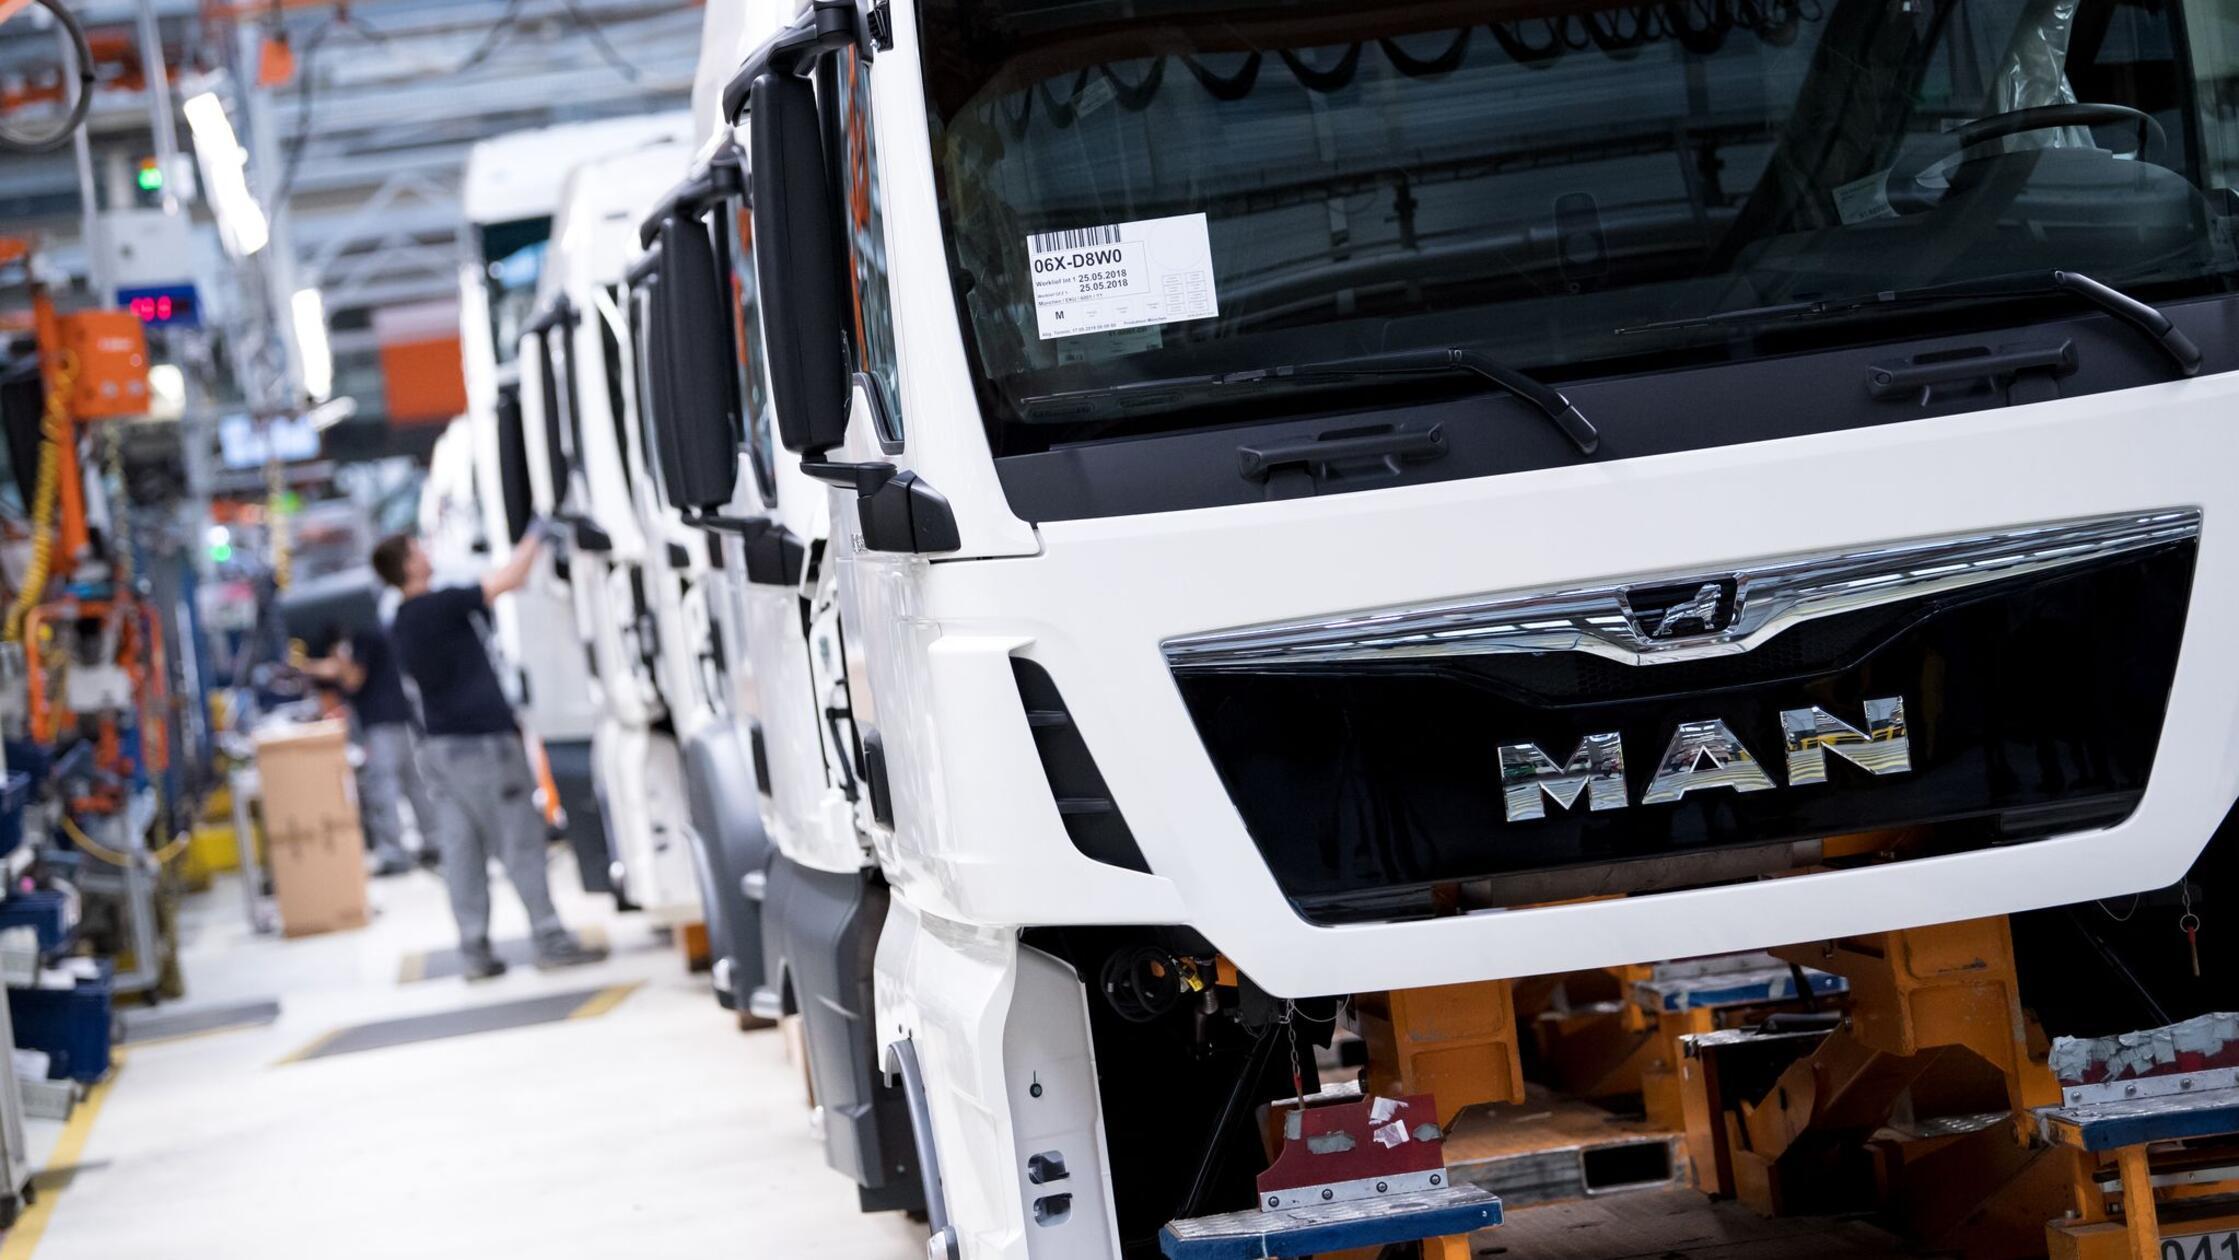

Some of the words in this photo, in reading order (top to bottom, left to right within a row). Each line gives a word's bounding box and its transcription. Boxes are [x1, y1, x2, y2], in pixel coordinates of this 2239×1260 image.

[1034, 248, 1122, 273] 06X-D8W0
[1078, 269, 1128, 283] 25.05.2018
[1079, 278, 1129, 293] 25.05.2018
[1055, 310, 1065, 320] M
[1497, 695, 1912, 823] MAN
